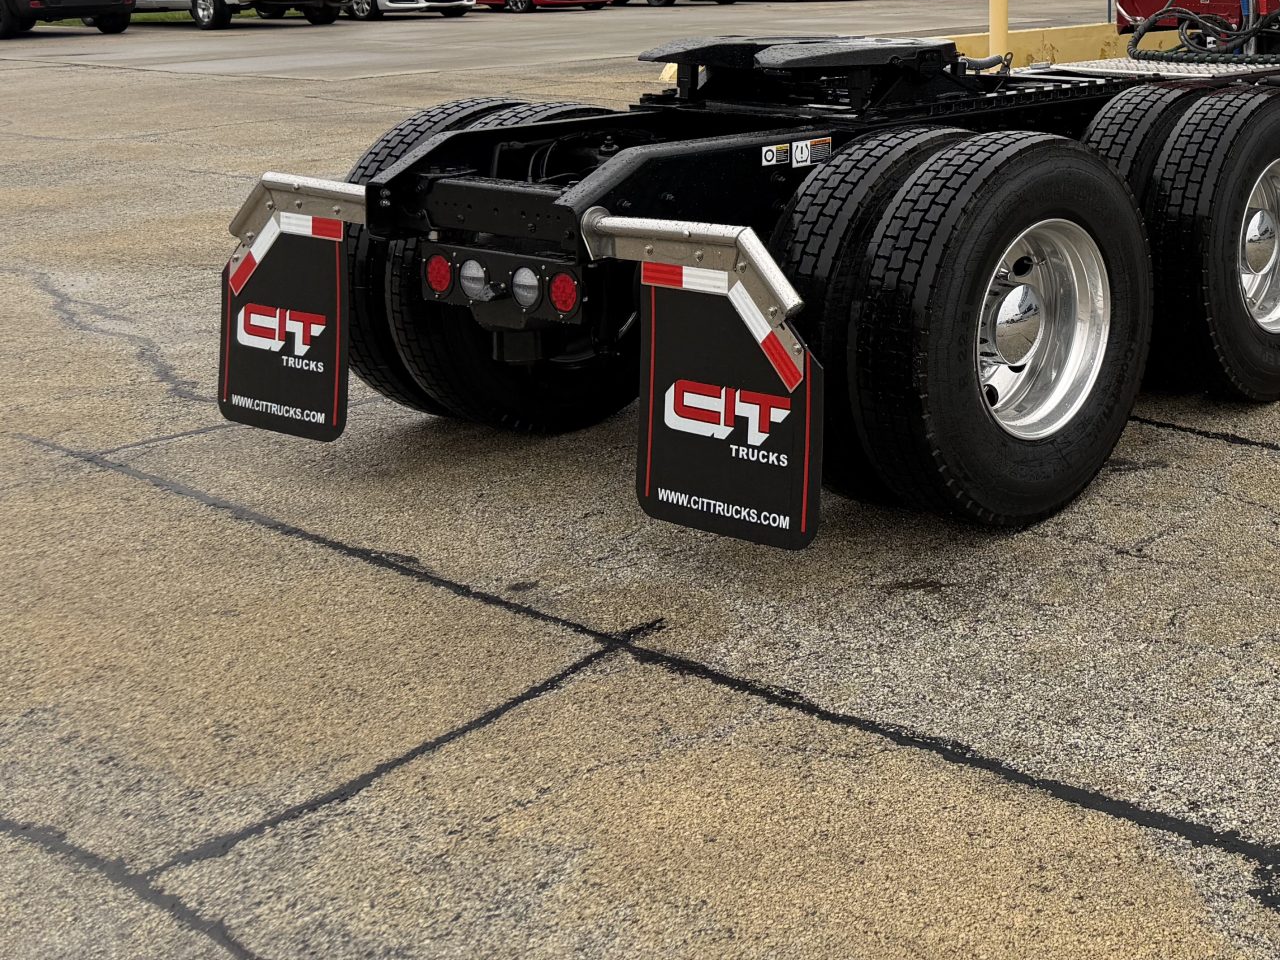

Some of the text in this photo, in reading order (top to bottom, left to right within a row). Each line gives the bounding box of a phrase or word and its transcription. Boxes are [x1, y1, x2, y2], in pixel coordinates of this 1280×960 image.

[237, 303, 326, 356] CIT
[281, 355, 324, 373] TRUCKS
[231, 393, 325, 424] WWW.CITTRUCKS.COM
[664, 379, 791, 446] CIT
[729, 444, 789, 467] TRUCKS
[657, 487, 790, 530] WWW.CITTRUCKS.COM
